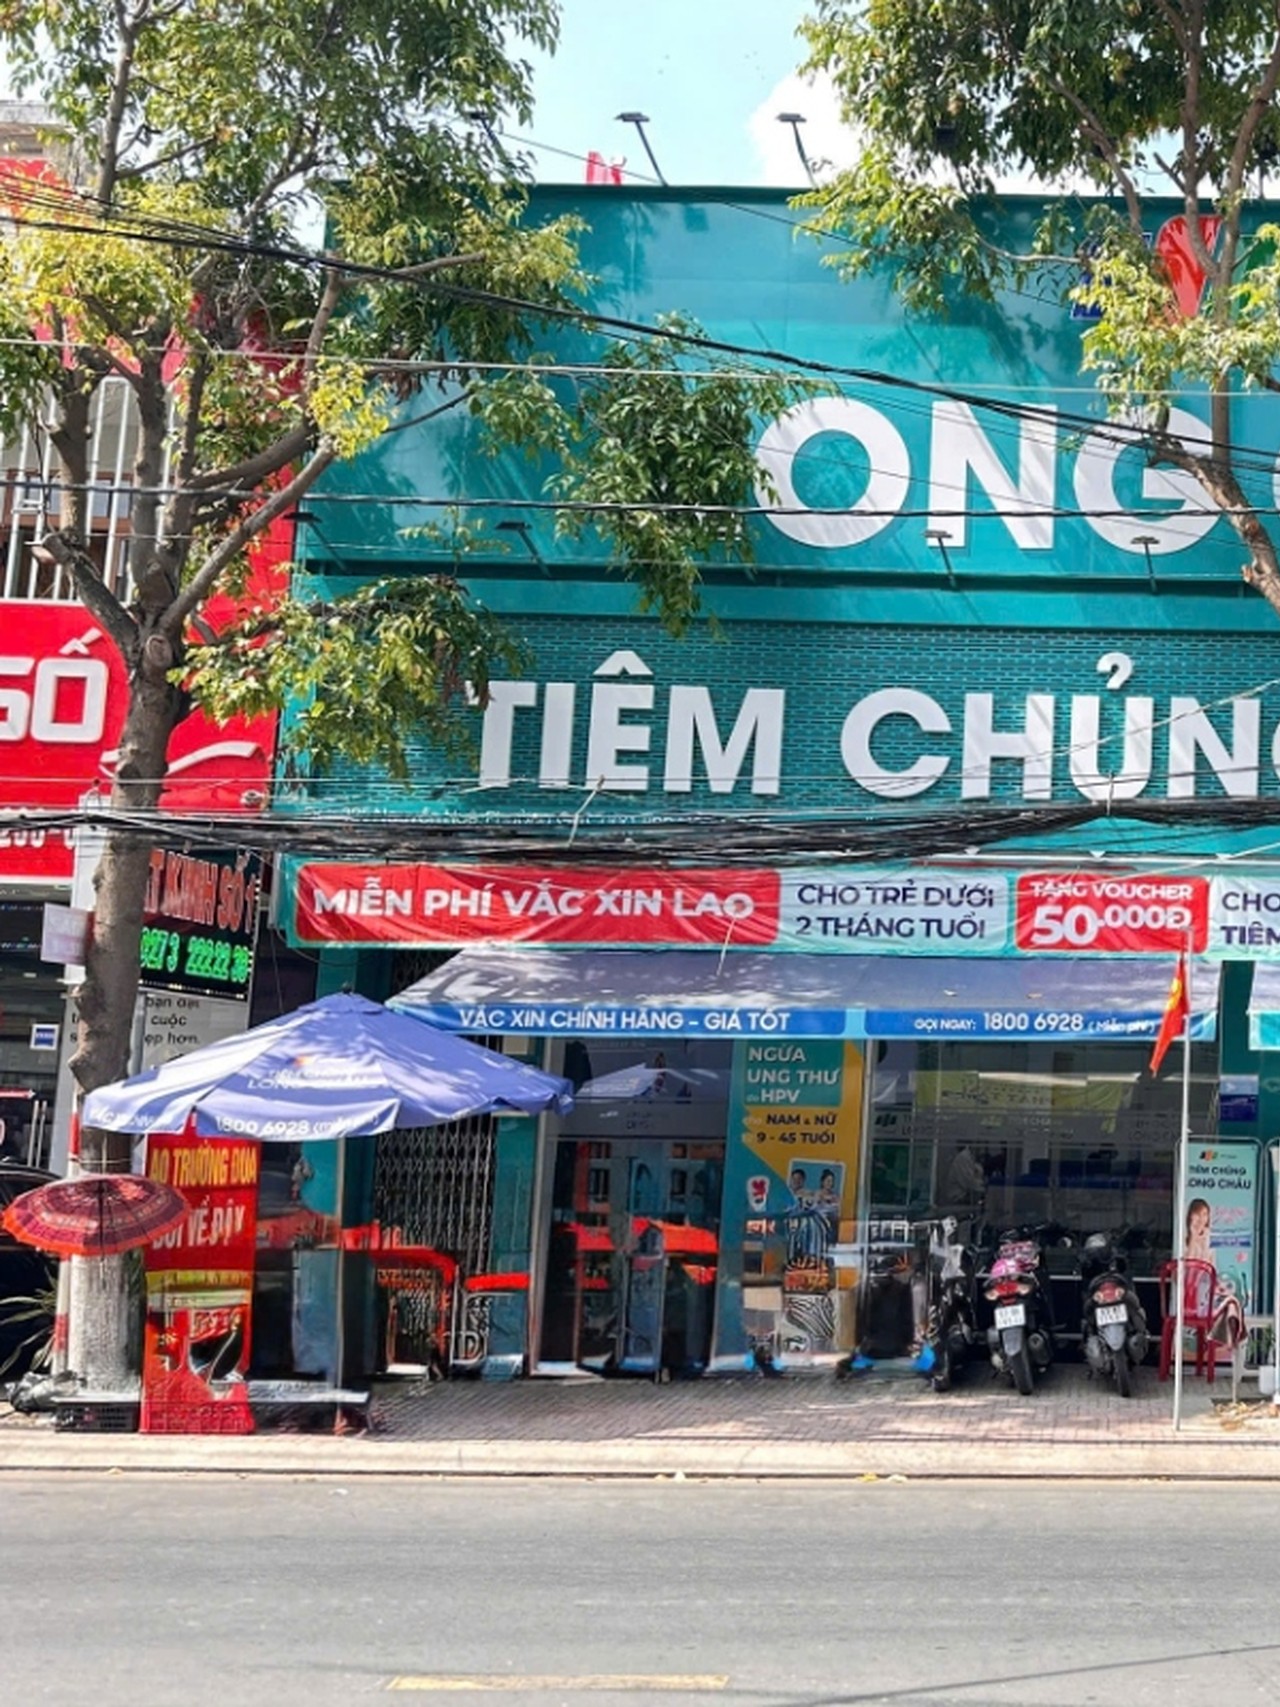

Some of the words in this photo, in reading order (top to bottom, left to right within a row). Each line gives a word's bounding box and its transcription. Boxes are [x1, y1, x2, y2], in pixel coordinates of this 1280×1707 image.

[690, 396, 1224, 555] ONG
[465, 651, 786, 797] TIÊM
[313, 876, 412, 917] MIỄN
[423, 882, 495, 918] PHÍ
[502, 880, 584, 918] VẮC
[595, 887, 665, 919] XIN
[673, 890, 755, 919] LAO
[798, 883, 860, 905] CHO
[866, 878, 918, 906] TRẺ
[1092, 882, 1194, 902] VOUCHER
[795, 916, 812, 936] 2
[816, 912, 915, 938] THÁNG
[920, 911, 985, 939] TUỔI
[1030, 903, 1193, 948] 50.000Đ
[458, 1004, 505, 1029] VẮC
[508, 1008, 547, 1029] XIN
[551, 1004, 616, 1030] CHÍNH
[704, 1005, 742, 1032] GIÁ
[747, 1005, 790, 1032] TỐT
[983, 1011, 1029, 1032] 1800
[1033, 1012, 1084, 1033] 6928
[795, 1068, 841, 1085] THƯ
[761, 1089, 801, 1103] HPV
[259, 1120, 310, 1138] 6928
[766, 1113, 801, 1126] NAM
[814, 1111, 837, 1126] NỮ
[756, 1132, 768, 1144] 9
[778, 1132, 797, 1145] 45
